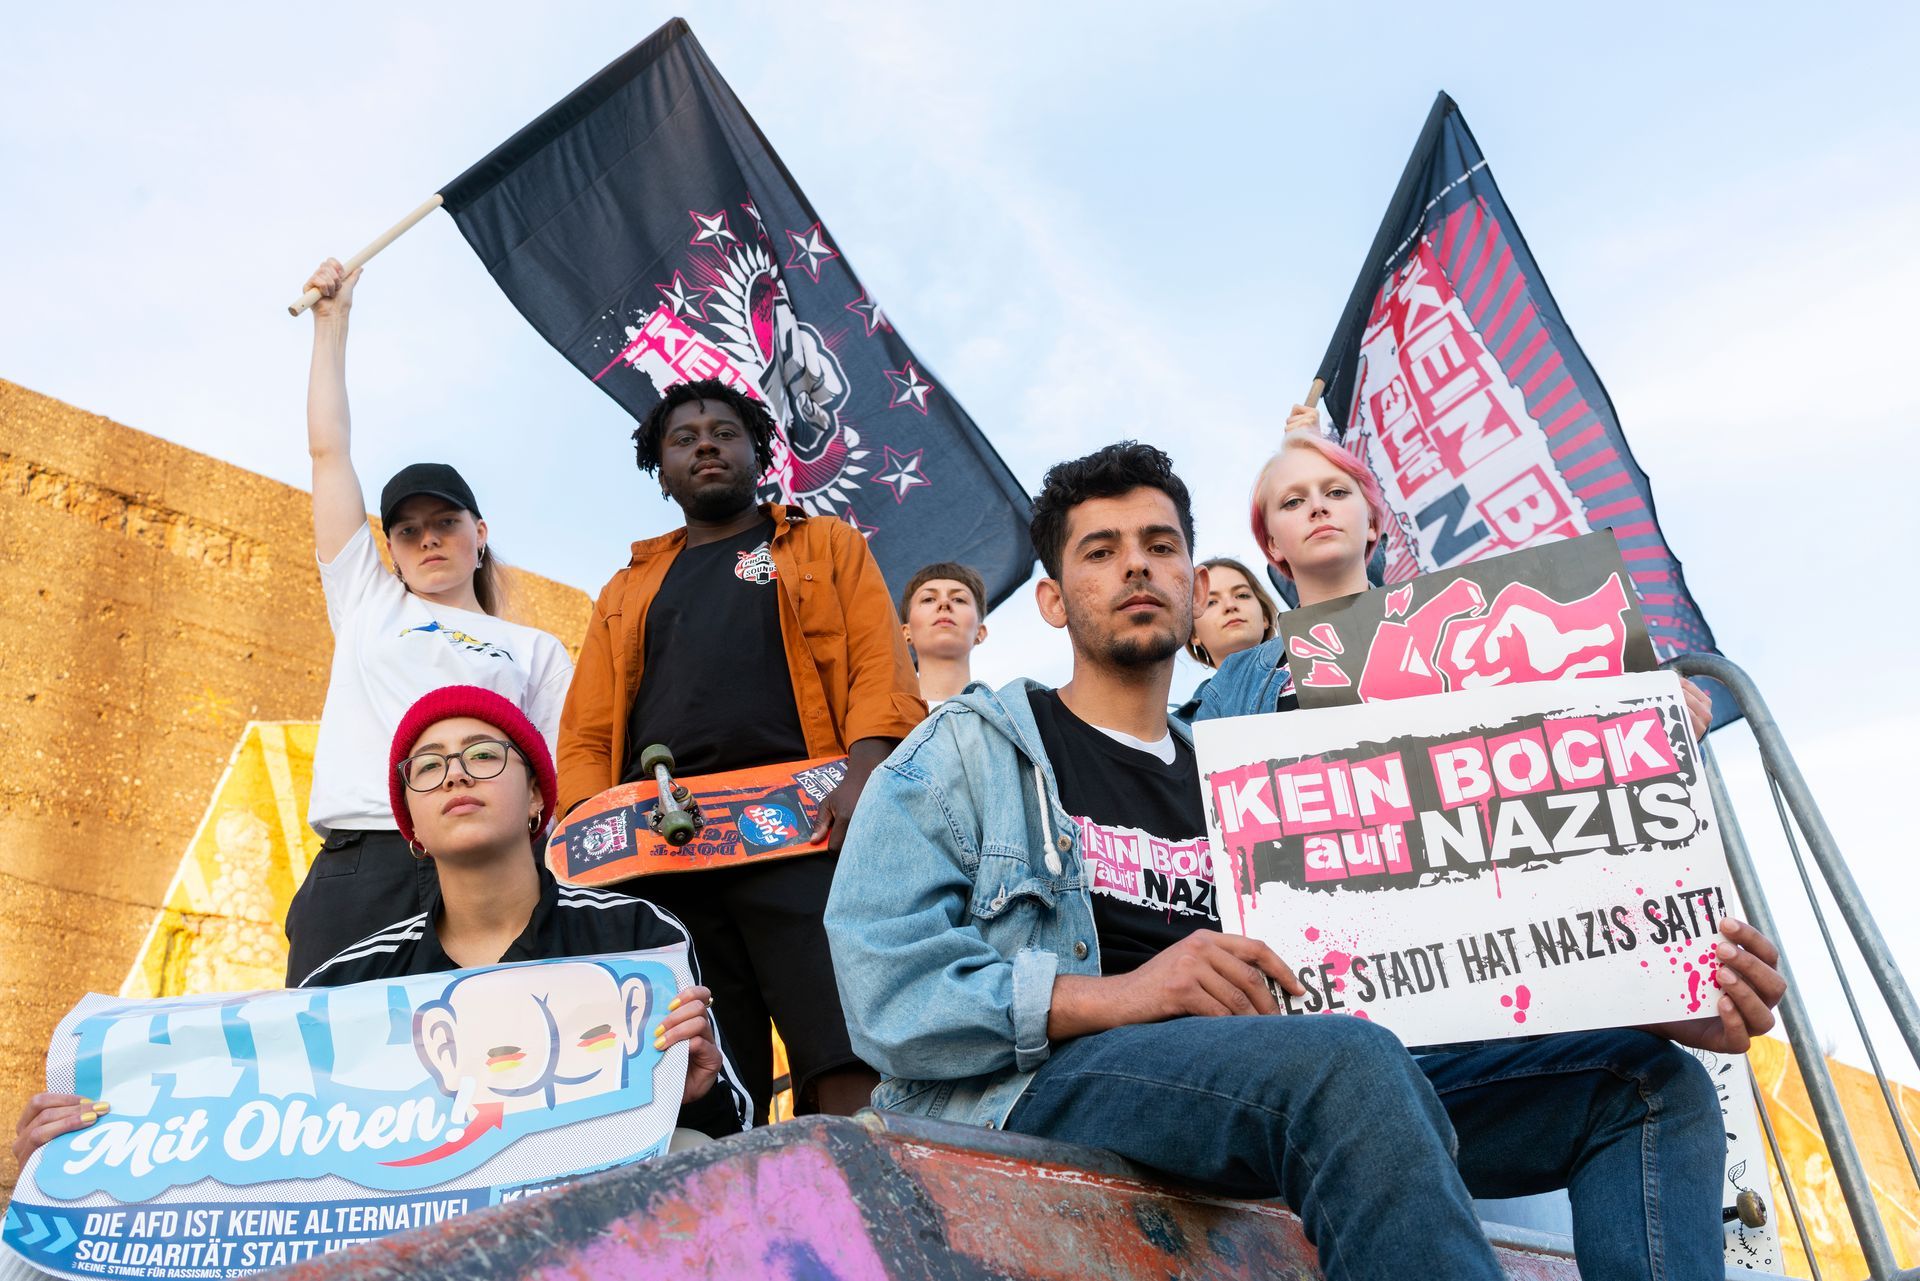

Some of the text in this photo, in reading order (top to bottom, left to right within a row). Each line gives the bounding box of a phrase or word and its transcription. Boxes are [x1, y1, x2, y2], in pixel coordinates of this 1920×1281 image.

[1398, 257, 1515, 470] KEIN
[1380, 378, 1444, 484] auf
[1218, 719, 1669, 833] KEIN BOCK
[749, 807, 779, 844] FUCK
[1304, 782, 1697, 870] auf NAZIS
[1096, 862, 1135, 891] auf
[1351, 943, 1450, 1003] STADT
[1457, 928, 1521, 984] HAT
[1528, 905, 1638, 969] NAZIS
[63, 1076, 477, 1177] Mit Ohren!
[75, 1239, 237, 1267] SOLIDARITÄT
[241, 1240, 318, 1267] STATT
[83, 1198, 468, 1238] DIE AFD IST KEINE ALTERNATIVE!
[78, 1261, 108, 1273] KEINE
[107, 1264, 145, 1277] STIMME
[147, 1266, 167, 1278] FÜR
[167, 1267, 224, 1280] RASSISMUS,
